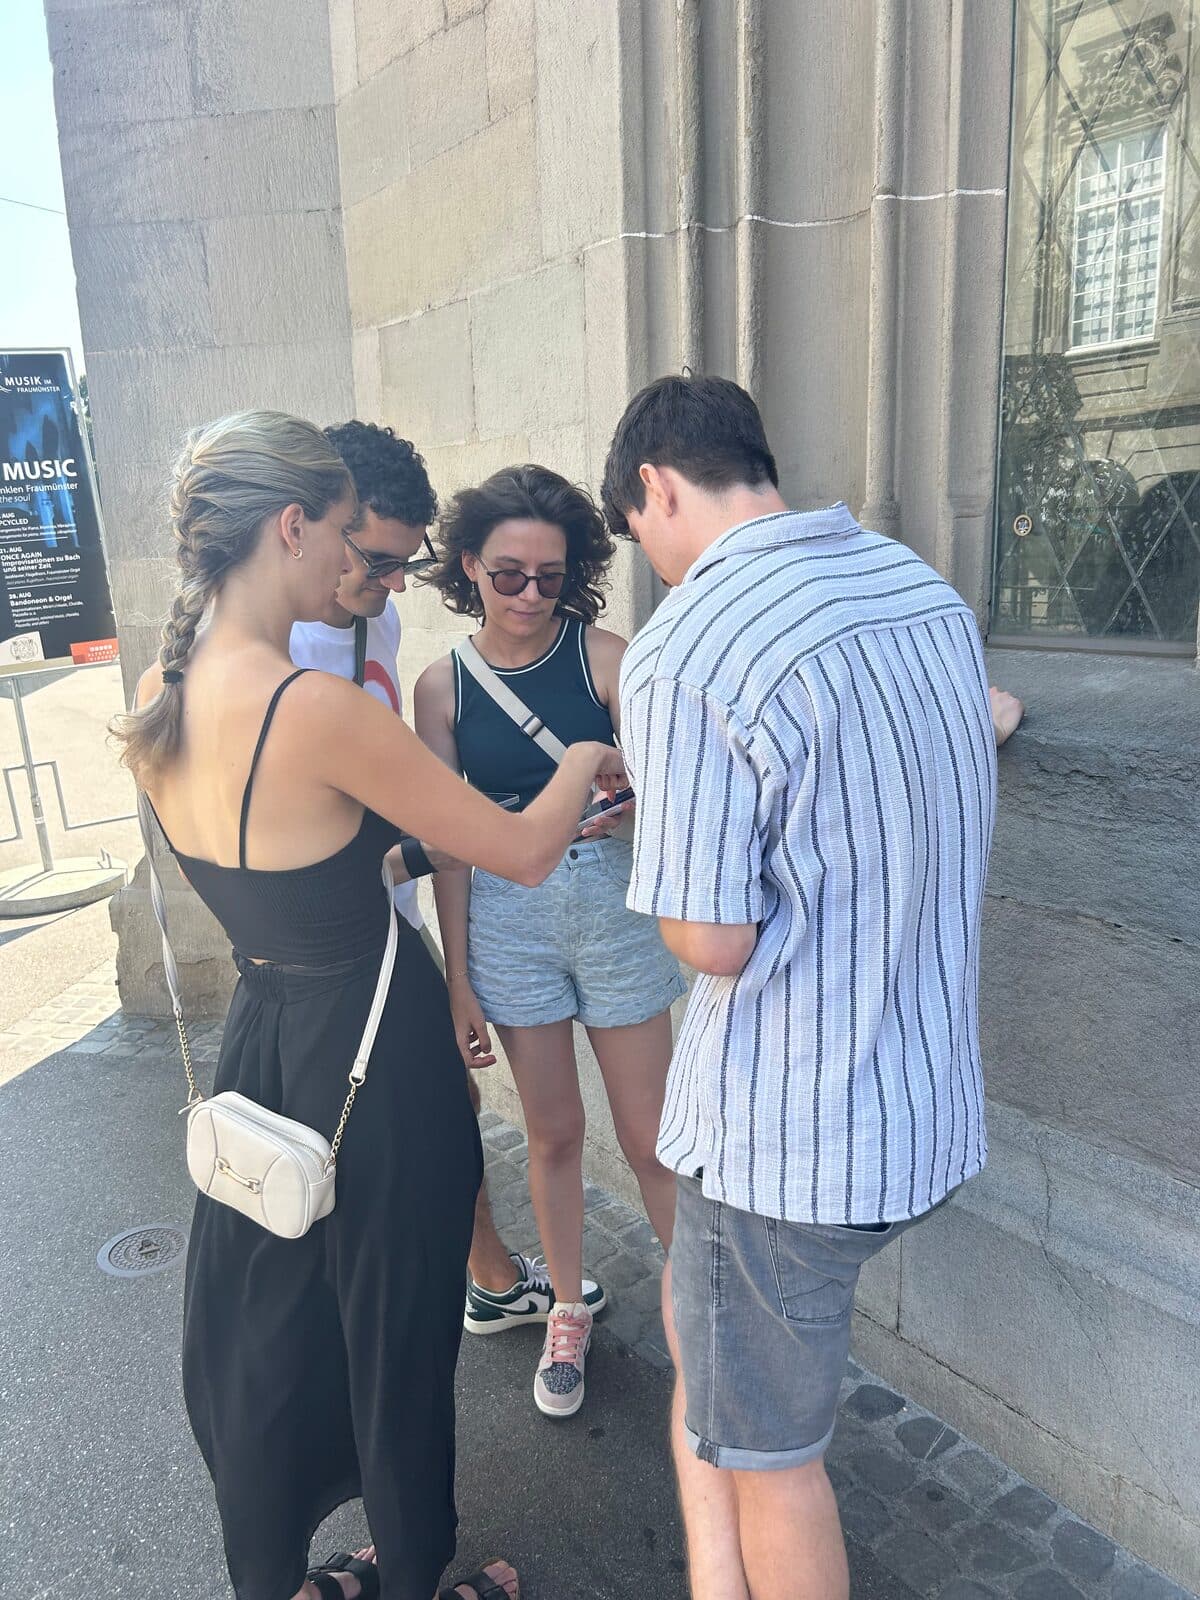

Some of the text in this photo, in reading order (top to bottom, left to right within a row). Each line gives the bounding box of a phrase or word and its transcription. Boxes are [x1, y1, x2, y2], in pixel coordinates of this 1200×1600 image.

[4, 376, 42, 386] MUSIK
[2, 458, 77, 481] MUSIC
[25, 482, 78, 493] Fraumünster
[14, 493, 31, 503] soul
[0, 551, 43, 561] ONCE AGAIN
[64, 553, 80, 561] Bach
[18, 564, 37, 572] seiner
[18, 591, 32, 599] AUG
[54, 593, 73, 602] Orgel
